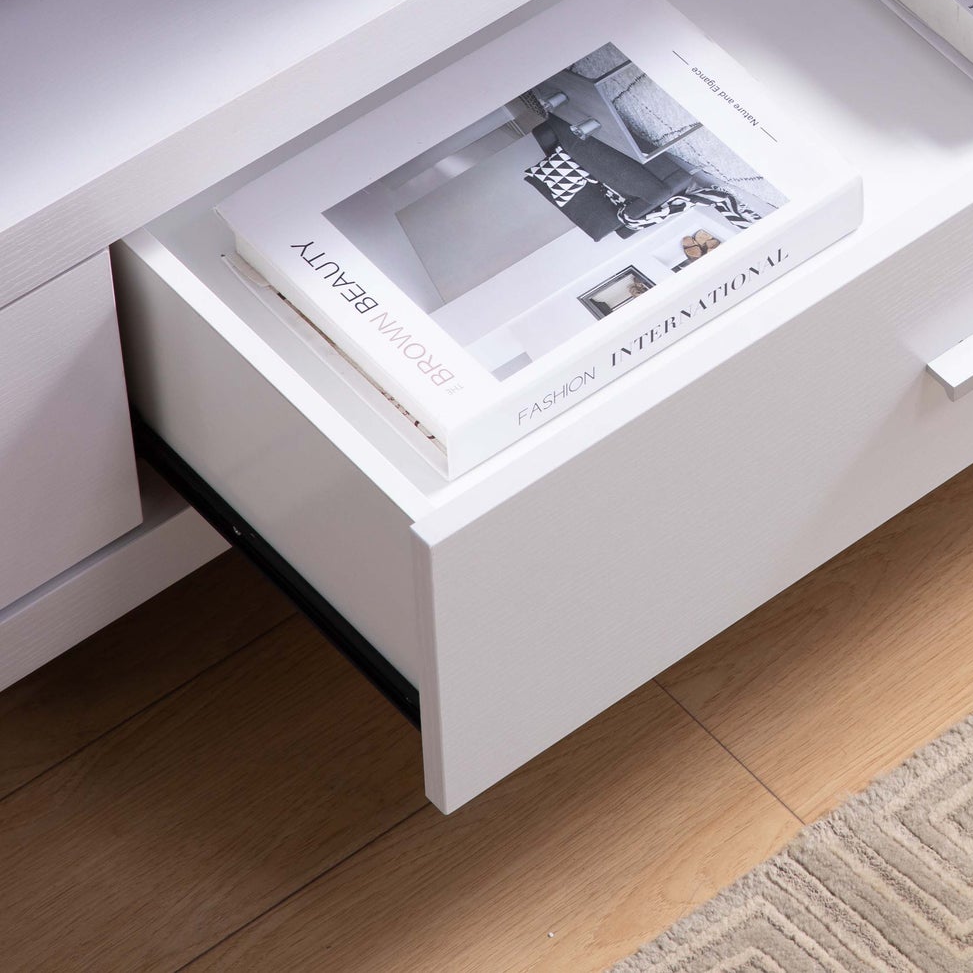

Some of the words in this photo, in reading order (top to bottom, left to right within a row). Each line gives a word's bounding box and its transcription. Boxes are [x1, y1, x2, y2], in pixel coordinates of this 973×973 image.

[691, 66, 721, 93] Elgance
[717, 90, 735, 105] and
[733, 103, 760, 127] Nature
[290, 241, 379, 314] BEAUTY
[369, 311, 455, 387] BROWN
[517, 366, 596, 426] FASHION
[610, 247, 790, 367] INTERNATIONAL
